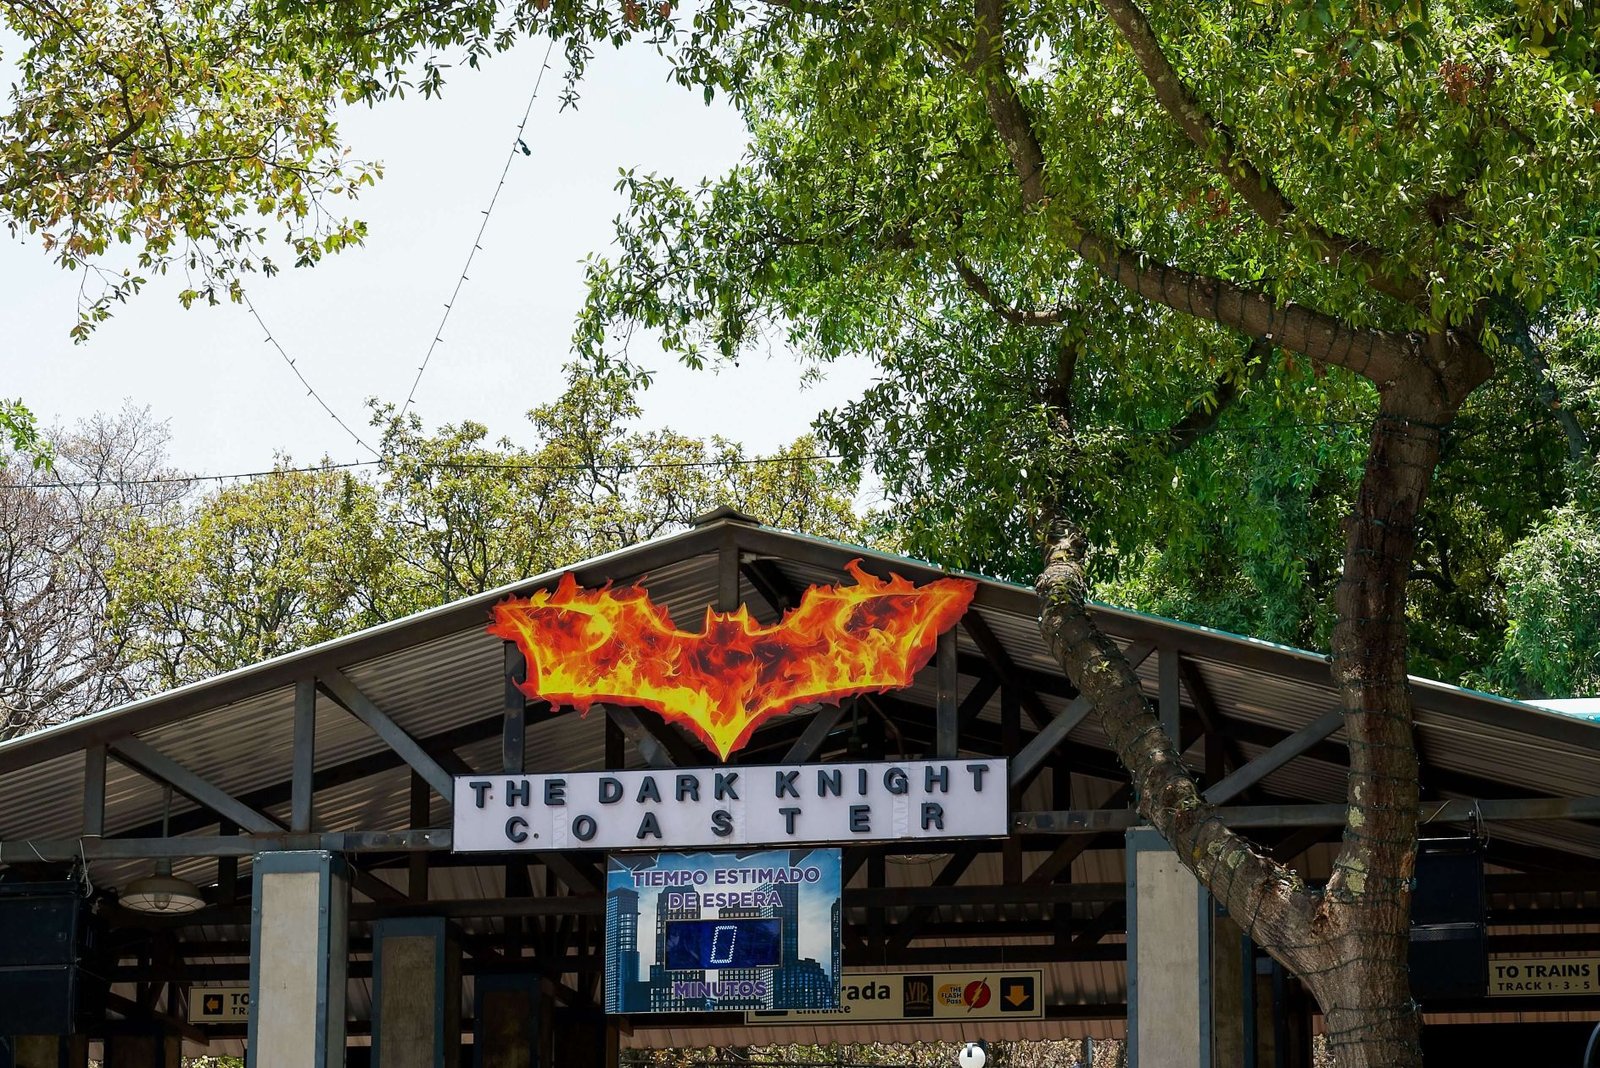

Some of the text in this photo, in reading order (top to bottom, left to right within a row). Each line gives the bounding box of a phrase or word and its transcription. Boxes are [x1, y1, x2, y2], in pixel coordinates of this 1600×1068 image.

[469, 764, 989, 808] THE DARK KNIGHT
[631, 867, 821, 887] TIEMPO ESTIMADO
[668, 891, 783, 909] DE ESPERA
[710, 925, 738, 964] 0
[1495, 964, 1590, 978] TO TRAINS
[674, 981, 768, 999] MINUTOS
[908, 981, 928, 1001] VIP
[1497, 982, 1542, 991] TRACK
[231, 1007, 249, 1015] TR
